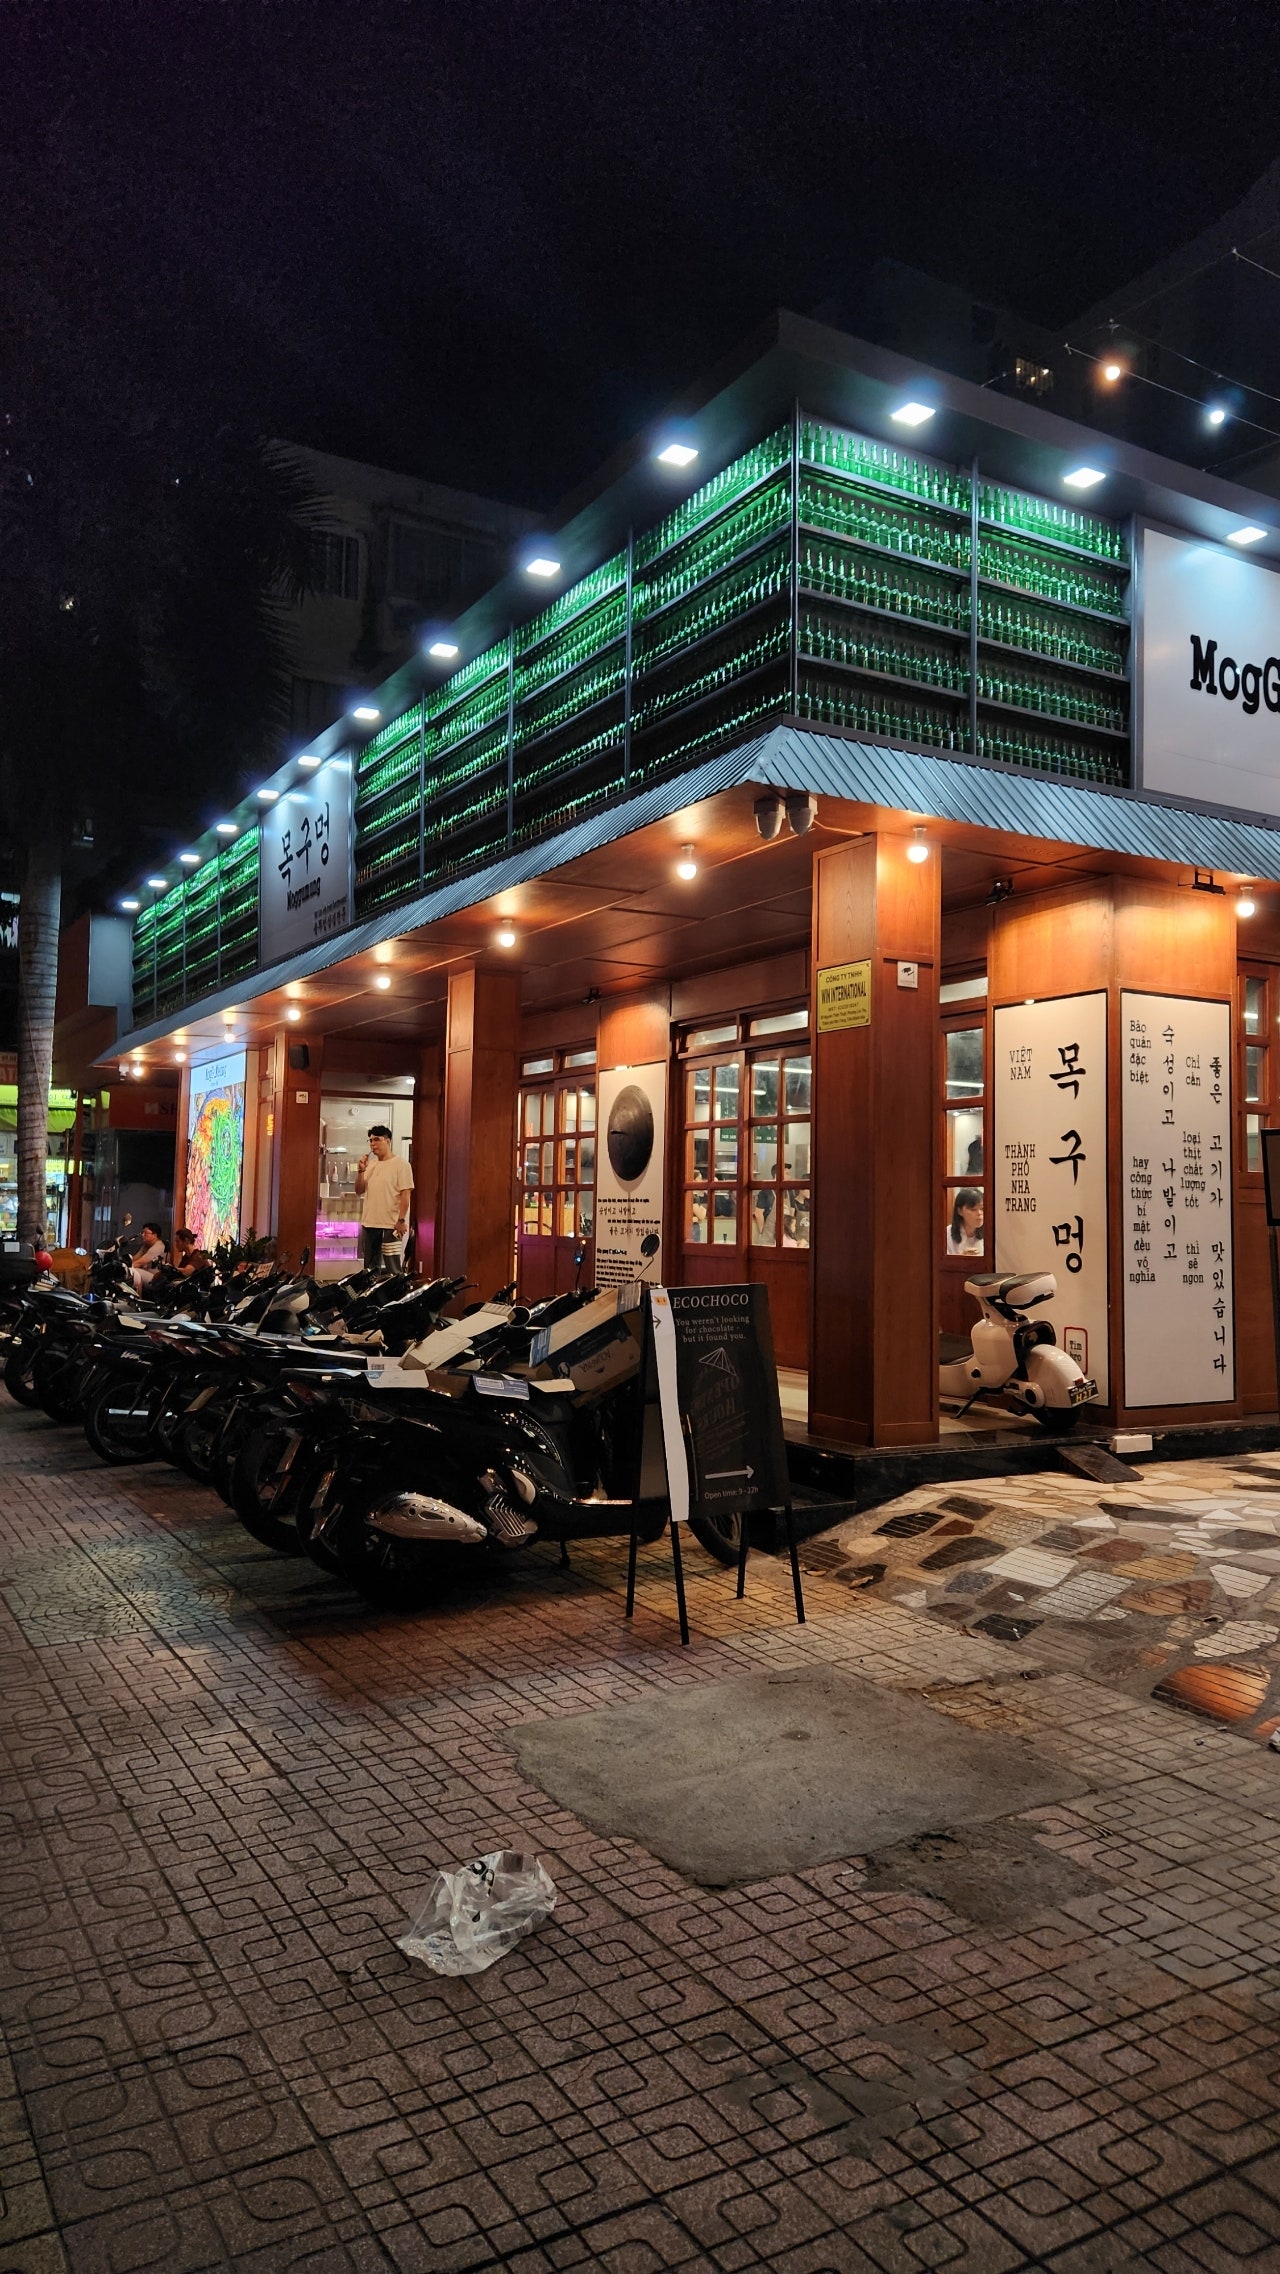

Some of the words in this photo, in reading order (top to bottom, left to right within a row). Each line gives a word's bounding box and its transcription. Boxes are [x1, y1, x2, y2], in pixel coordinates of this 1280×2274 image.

[278, 801, 330, 887] 목구멍
[840, 973, 848, 981] TY
[848, 970, 863, 979] TNHH
[821, 988, 831, 1004] WIN
[831, 981, 867, 1001] INTERNATIONAL
[1130, 1020, 1147, 1033] Bảo
[1129, 1036, 1152, 1049] quản
[1009, 1046, 1033, 1064] VIỆT
[1010, 1066, 1032, 1080] NAM
[1130, 1070, 1149, 1085] biệt
[1161, 1025, 1175, 1125] 숙성이고
[1209, 1056, 1223, 1104] 좋은
[1183, 1131, 1201, 1145] loại
[1005, 1141, 1036, 1159] THÀNH
[1183, 1147, 1201, 1160] thịt
[1049, 1043, 1087, 1274] 목구멍
[1133, 1156, 1149, 1169] hay
[1011, 1158, 1030, 1177] PHỐ
[1209, 1135, 1223, 1208] 고기가
[1130, 1171, 1152, 1184] công
[1011, 1179, 1030, 1194] NHA
[1005, 1197, 1037, 1212] TRANG
[1137, 1202, 1147, 1216] bí
[1162, 1158, 1177, 1259] 나발이고
[1133, 1220, 1151, 1234] mật
[1183, 1273, 1204, 1285] ngon
[673, 1293, 749, 1309] ECOCHOCO
[1211, 1241, 1227, 1376] 맛있습니다
[676, 1318, 690, 1326] You
[692, 1316, 720, 1325] weren't
[721, 1315, 750, 1324] looking
[685, 1326, 696, 1334] for
[700, 1325, 734, 1333] chocolate
[683, 1335, 695, 1343] but
[706, 1333, 728, 1341] found
[731, 1332, 746, 1340] you.
[704, 1491, 721, 1500] Open
[723, 1489, 737, 1497] time:
